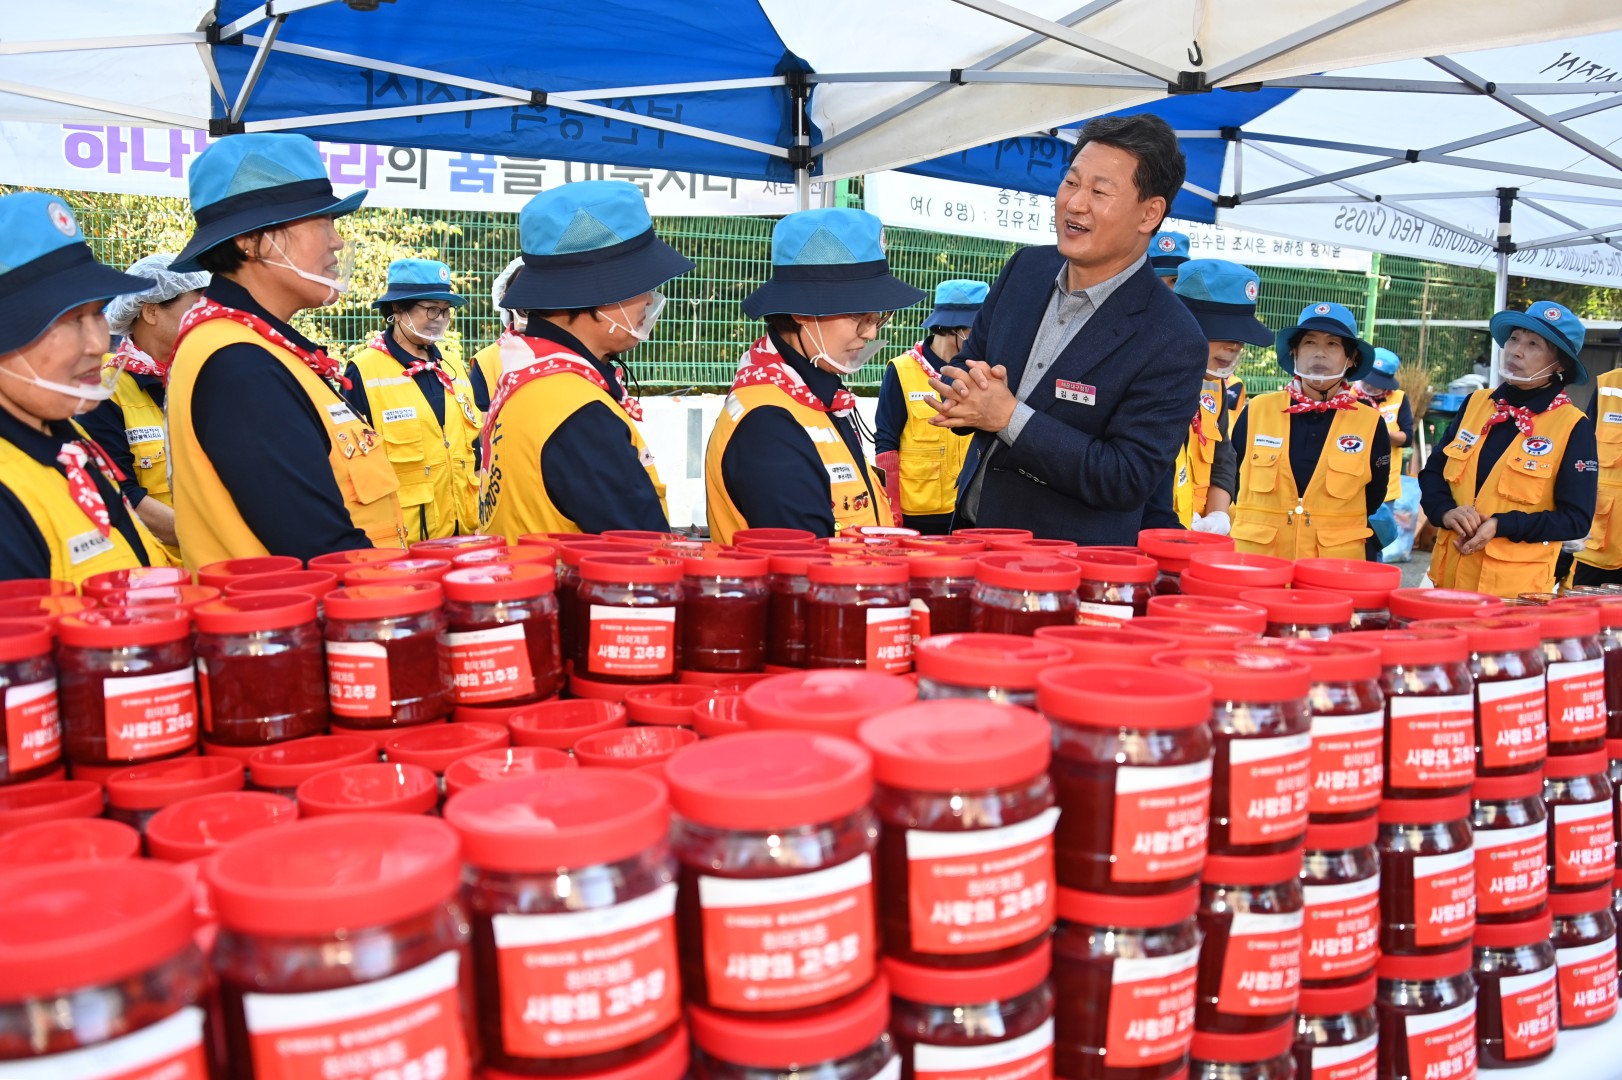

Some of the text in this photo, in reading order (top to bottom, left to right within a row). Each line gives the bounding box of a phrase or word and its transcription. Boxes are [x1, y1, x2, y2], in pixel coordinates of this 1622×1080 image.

[62, 124, 212, 178] 하나
[996, 209, 1040, 231] 김유진
[1232, 236, 1266, 254] 조시은
[597, 644, 667, 661] 사랑의 고추장
[482, 666, 519, 684] 고추장
[343, 684, 377, 700] 고추장
[120, 720, 163, 740] 사랑의
[1315, 769, 1359, 790] 사랑의
